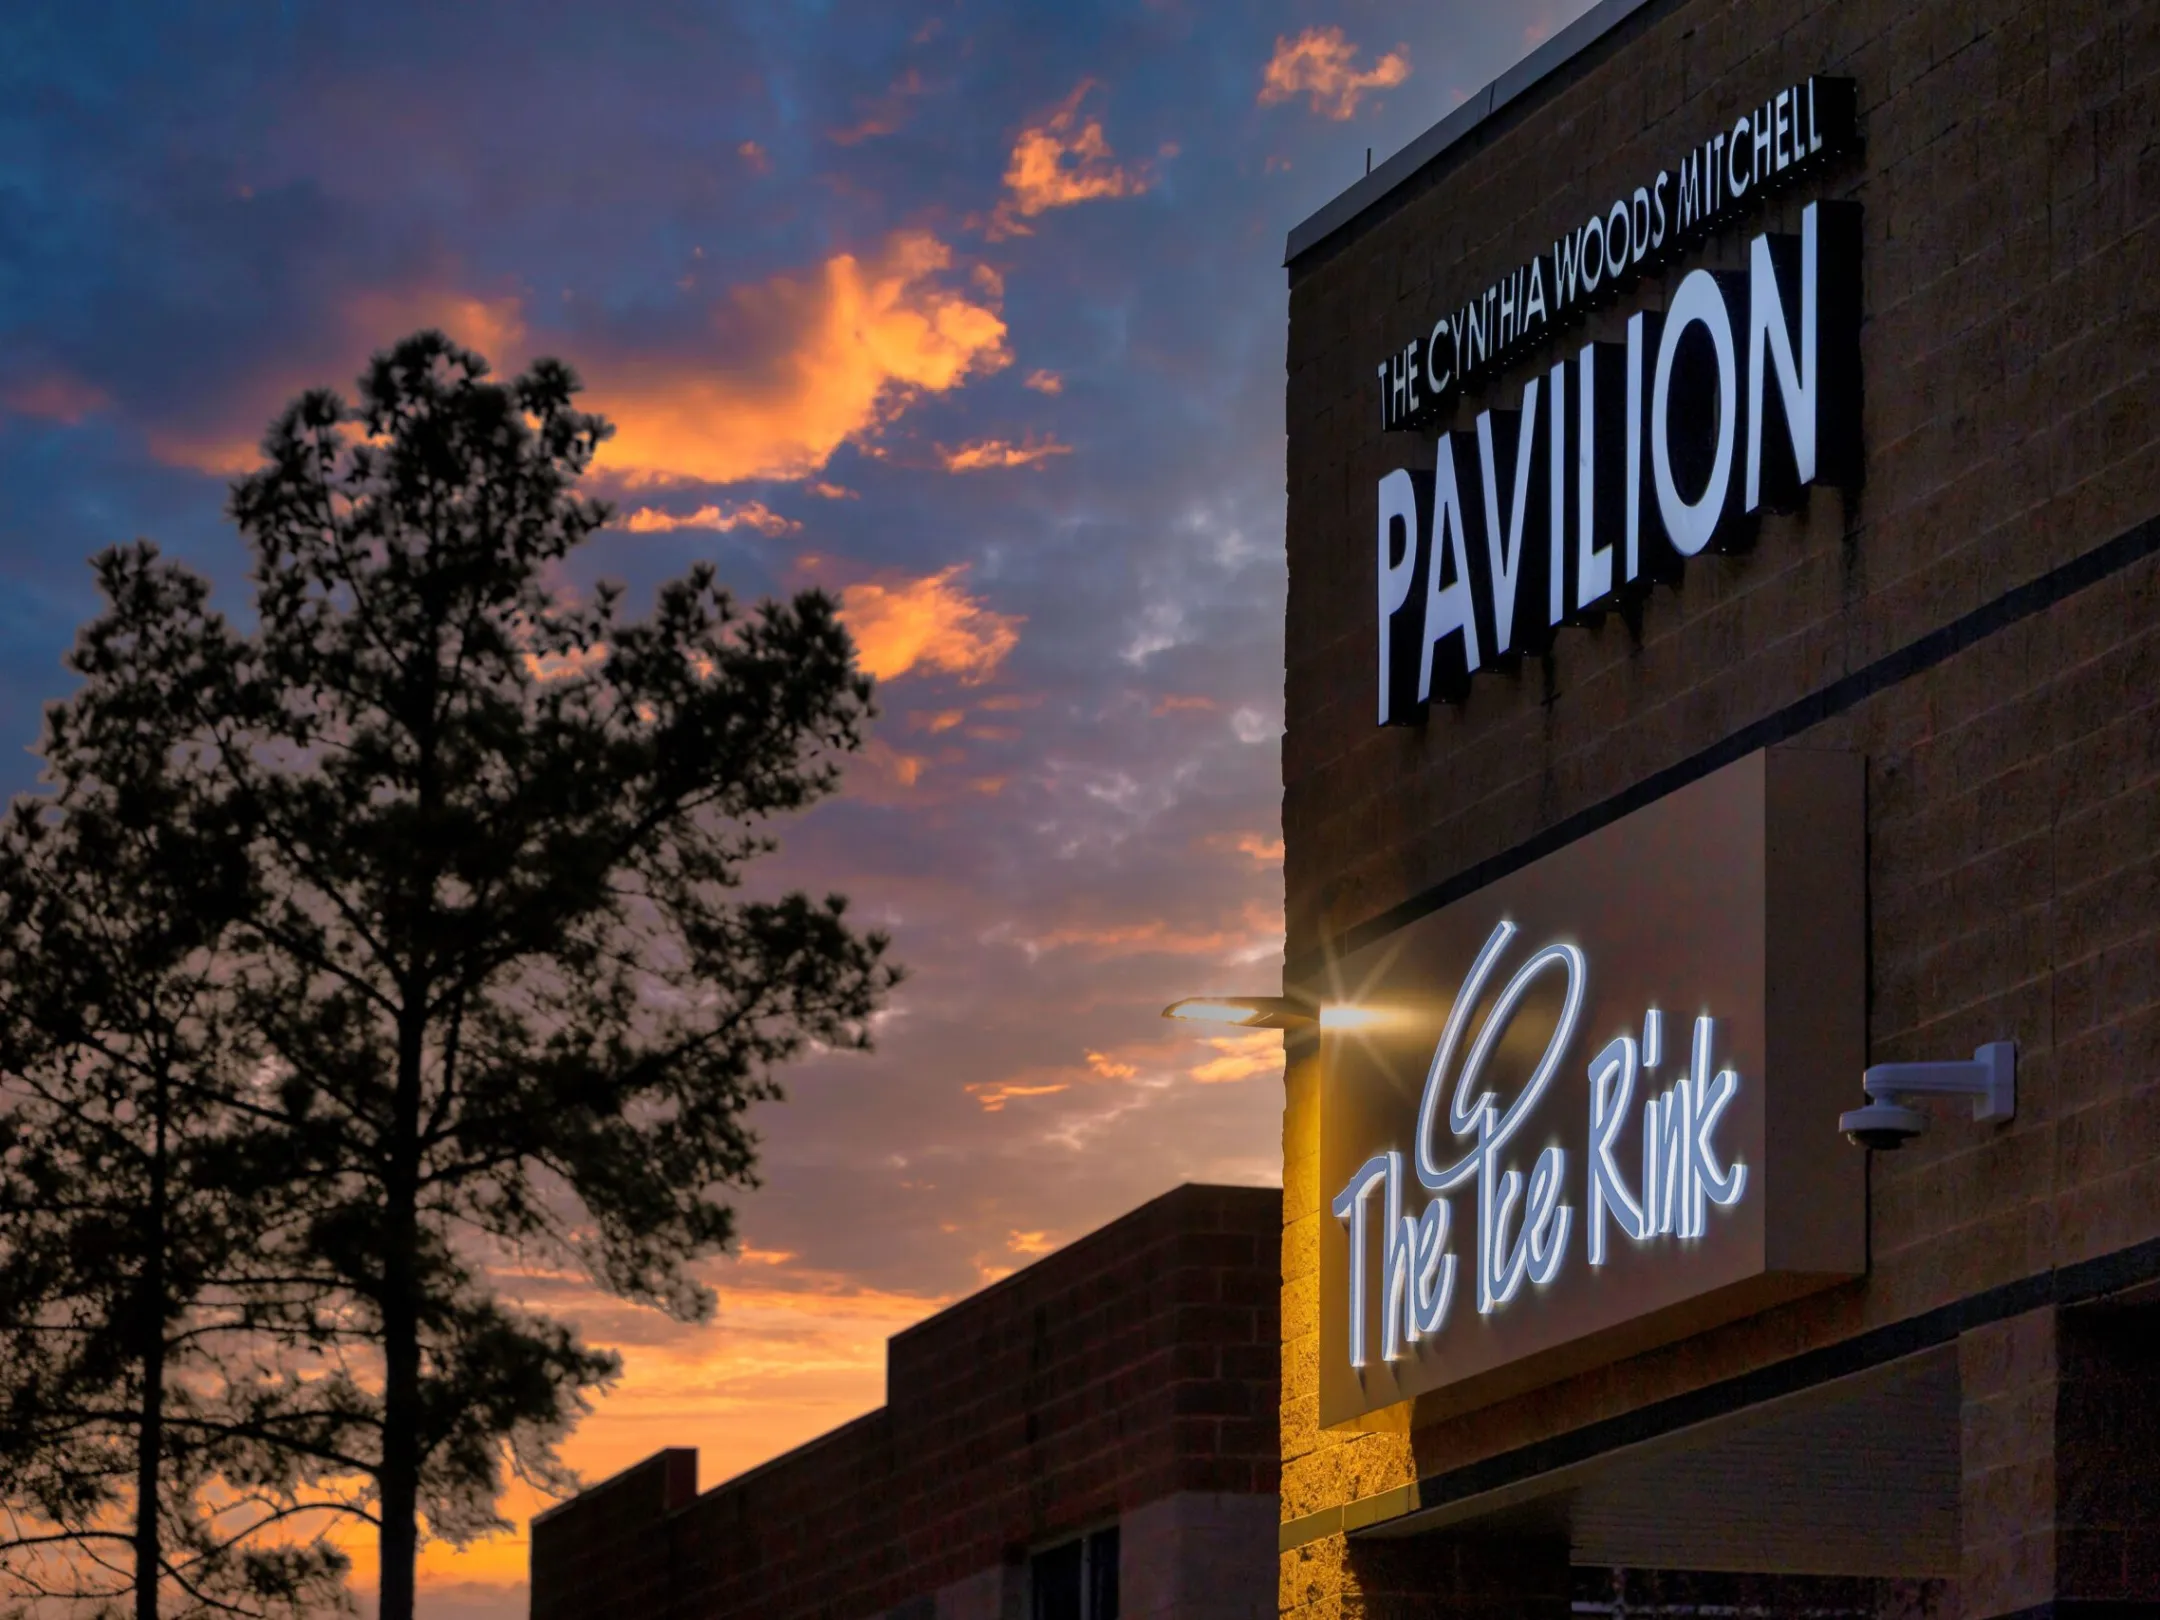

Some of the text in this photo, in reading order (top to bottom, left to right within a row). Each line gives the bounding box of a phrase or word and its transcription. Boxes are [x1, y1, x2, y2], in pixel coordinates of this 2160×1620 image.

[1377, 76, 1823, 431] THE CYNTHIA WOODS MITCHELL
[1377, 200, 1818, 726] PAVILION
[1332, 920, 1748, 1367] The Ice Rink
